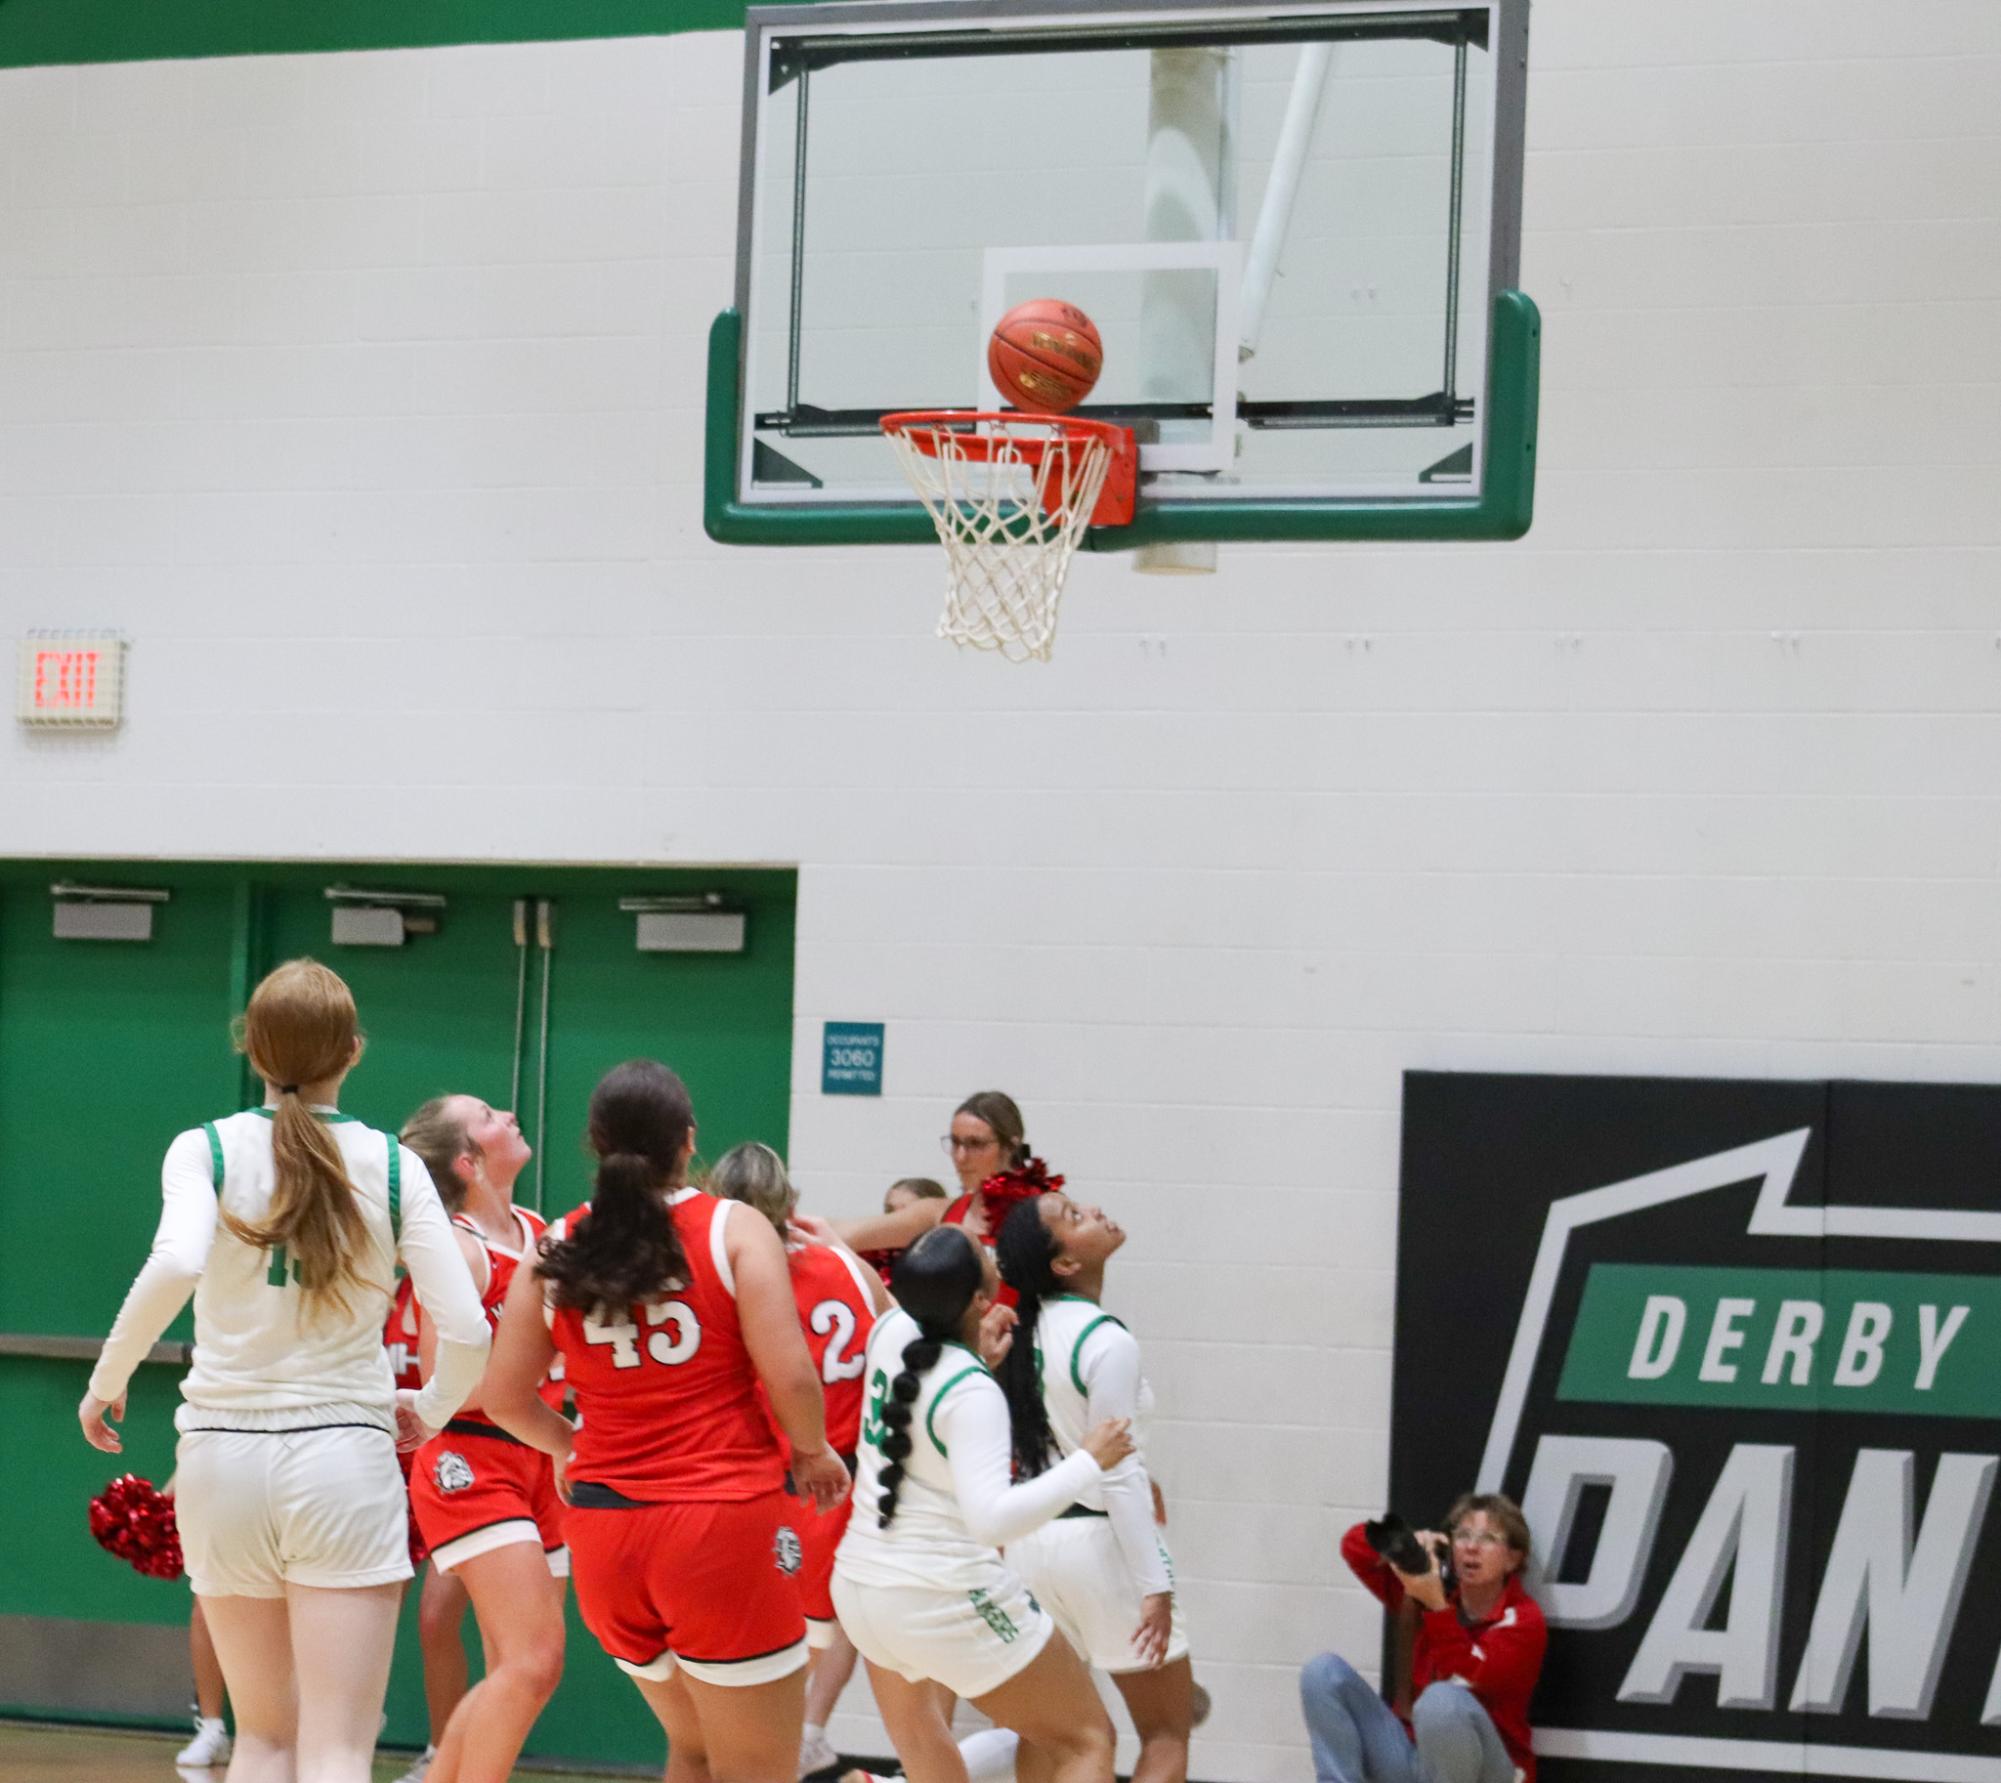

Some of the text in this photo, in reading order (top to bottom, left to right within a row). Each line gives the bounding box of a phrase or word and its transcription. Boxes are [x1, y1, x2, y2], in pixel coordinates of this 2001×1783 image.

[35, 651, 101, 708] EXIT
[831, 1048, 875, 1069] 3060
[583, 1277, 702, 1370] 45
[811, 1299, 866, 1385] 2
[1627, 1295, 1971, 1391] DERBY
[1520, 1434, 2001, 1724] PAN
